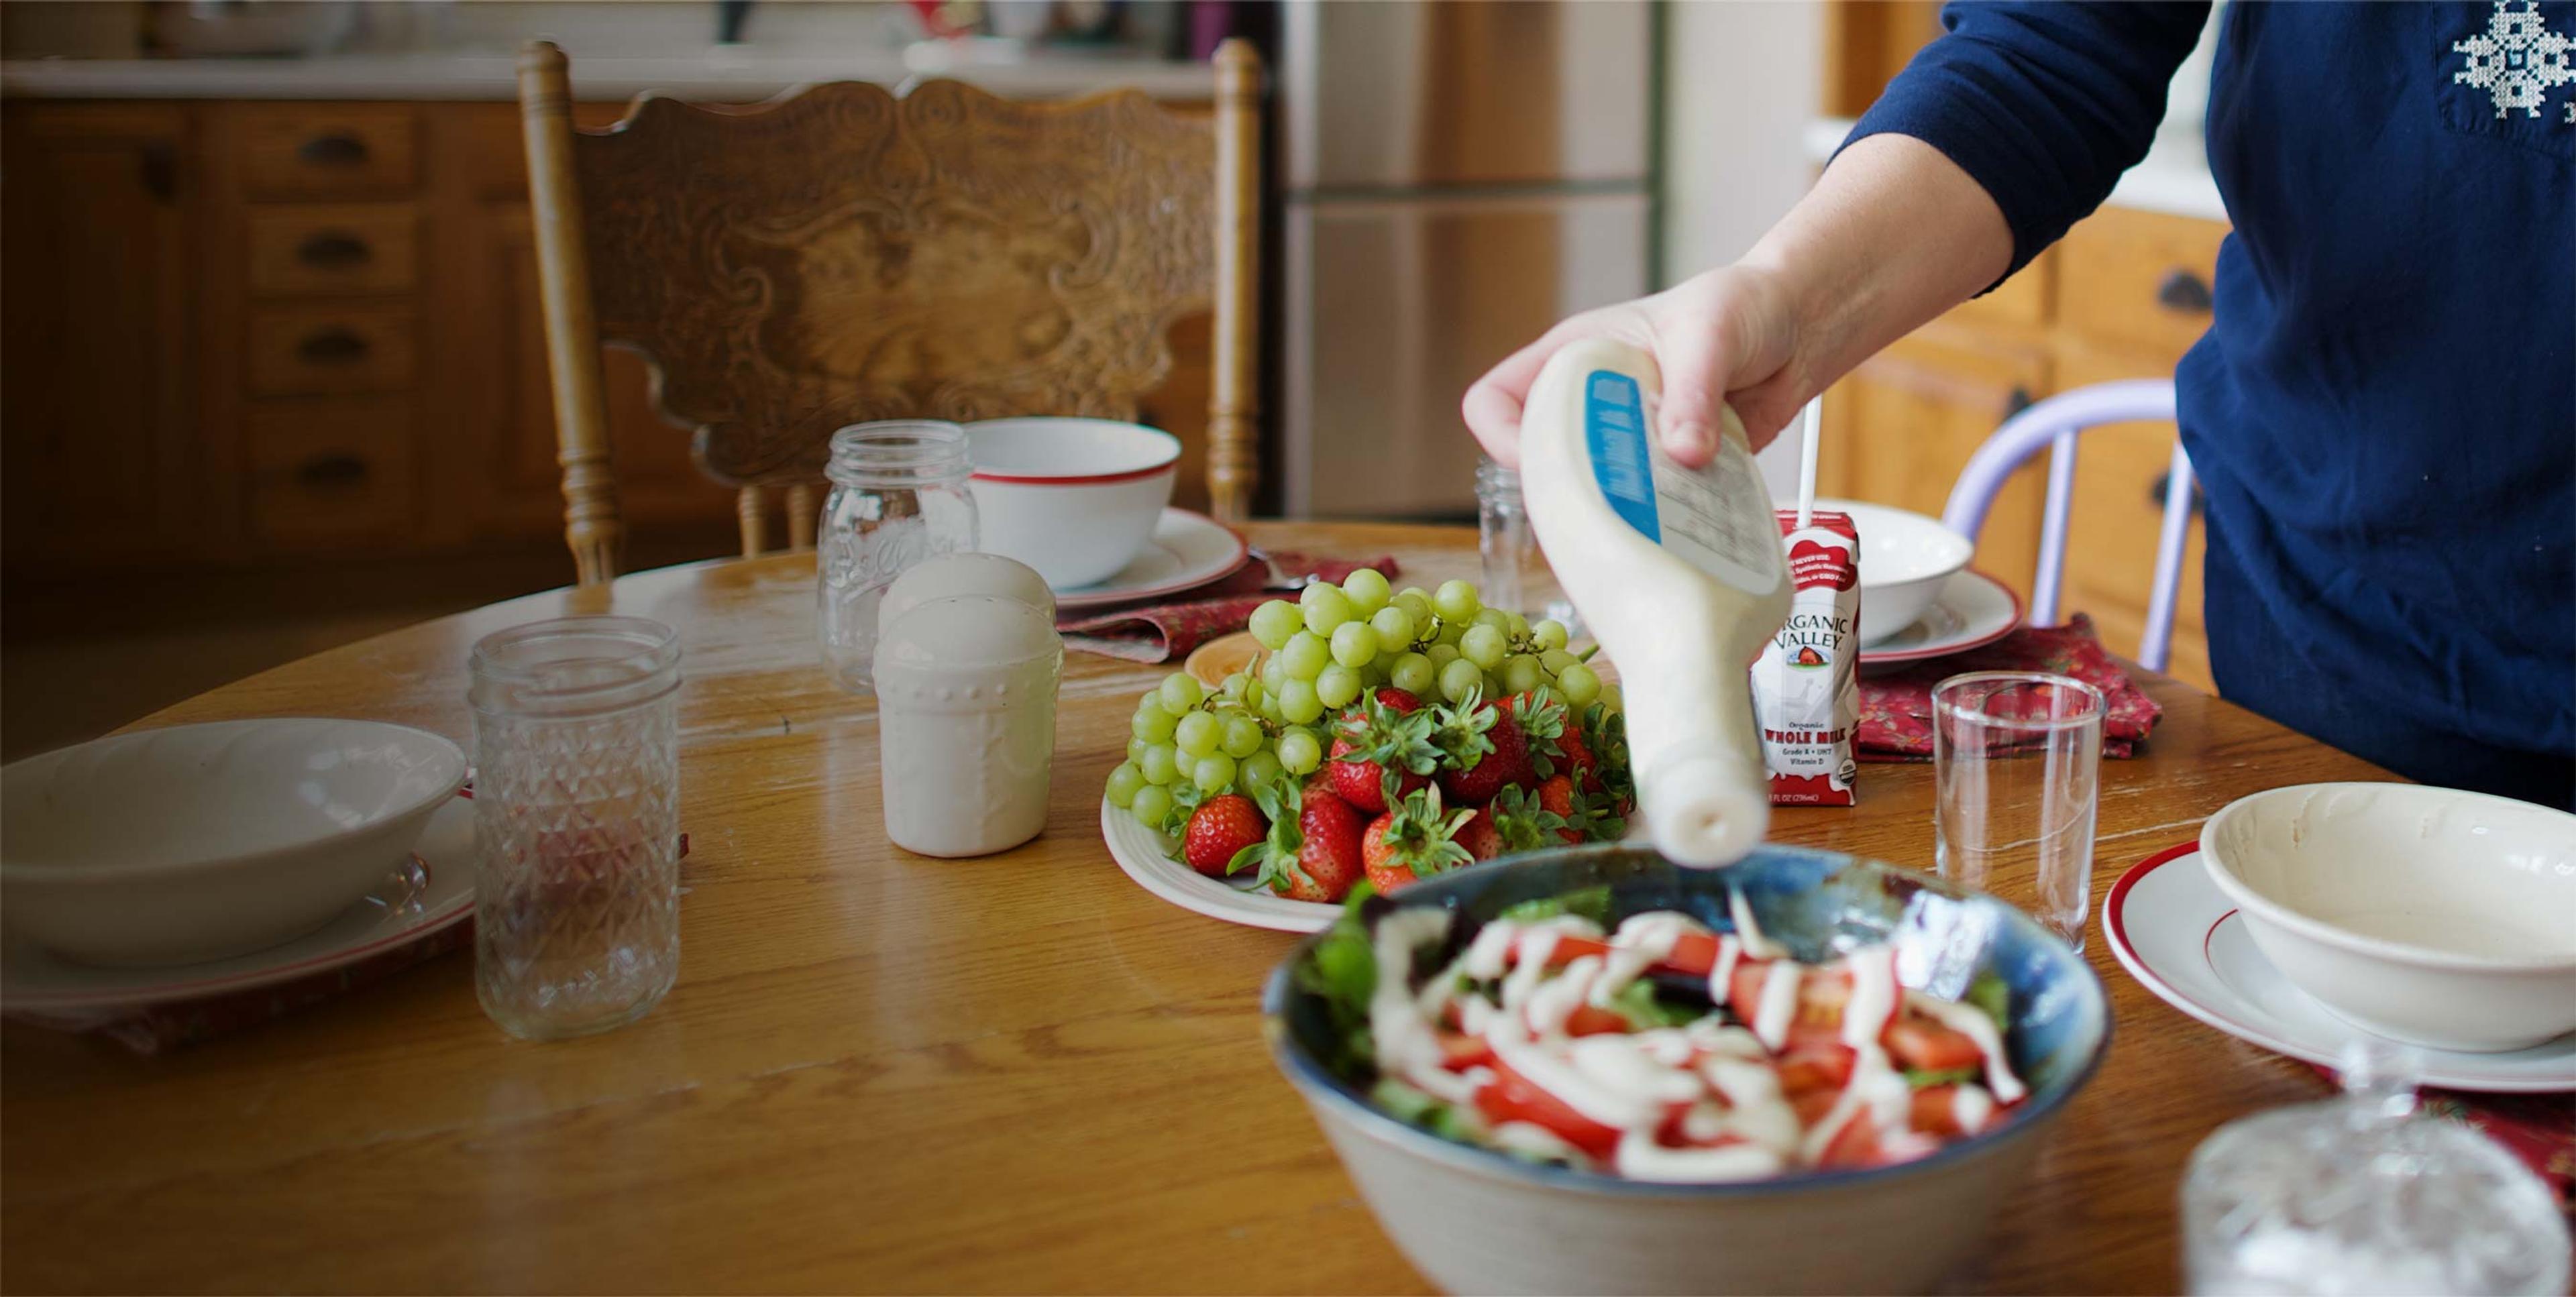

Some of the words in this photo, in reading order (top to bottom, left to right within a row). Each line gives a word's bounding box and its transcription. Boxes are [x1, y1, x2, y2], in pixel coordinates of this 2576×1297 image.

[1782, 614, 1848, 634] RGANIC
[1774, 632, 1843, 650] VALLEY
[1788, 722, 1825, 730] Organic
[1764, 728, 1811, 744] WHOLE
[1816, 728, 1846, 744] MILK
[1773, 794, 1780, 802] FL
[1782, 794, 1792, 802] OZ
